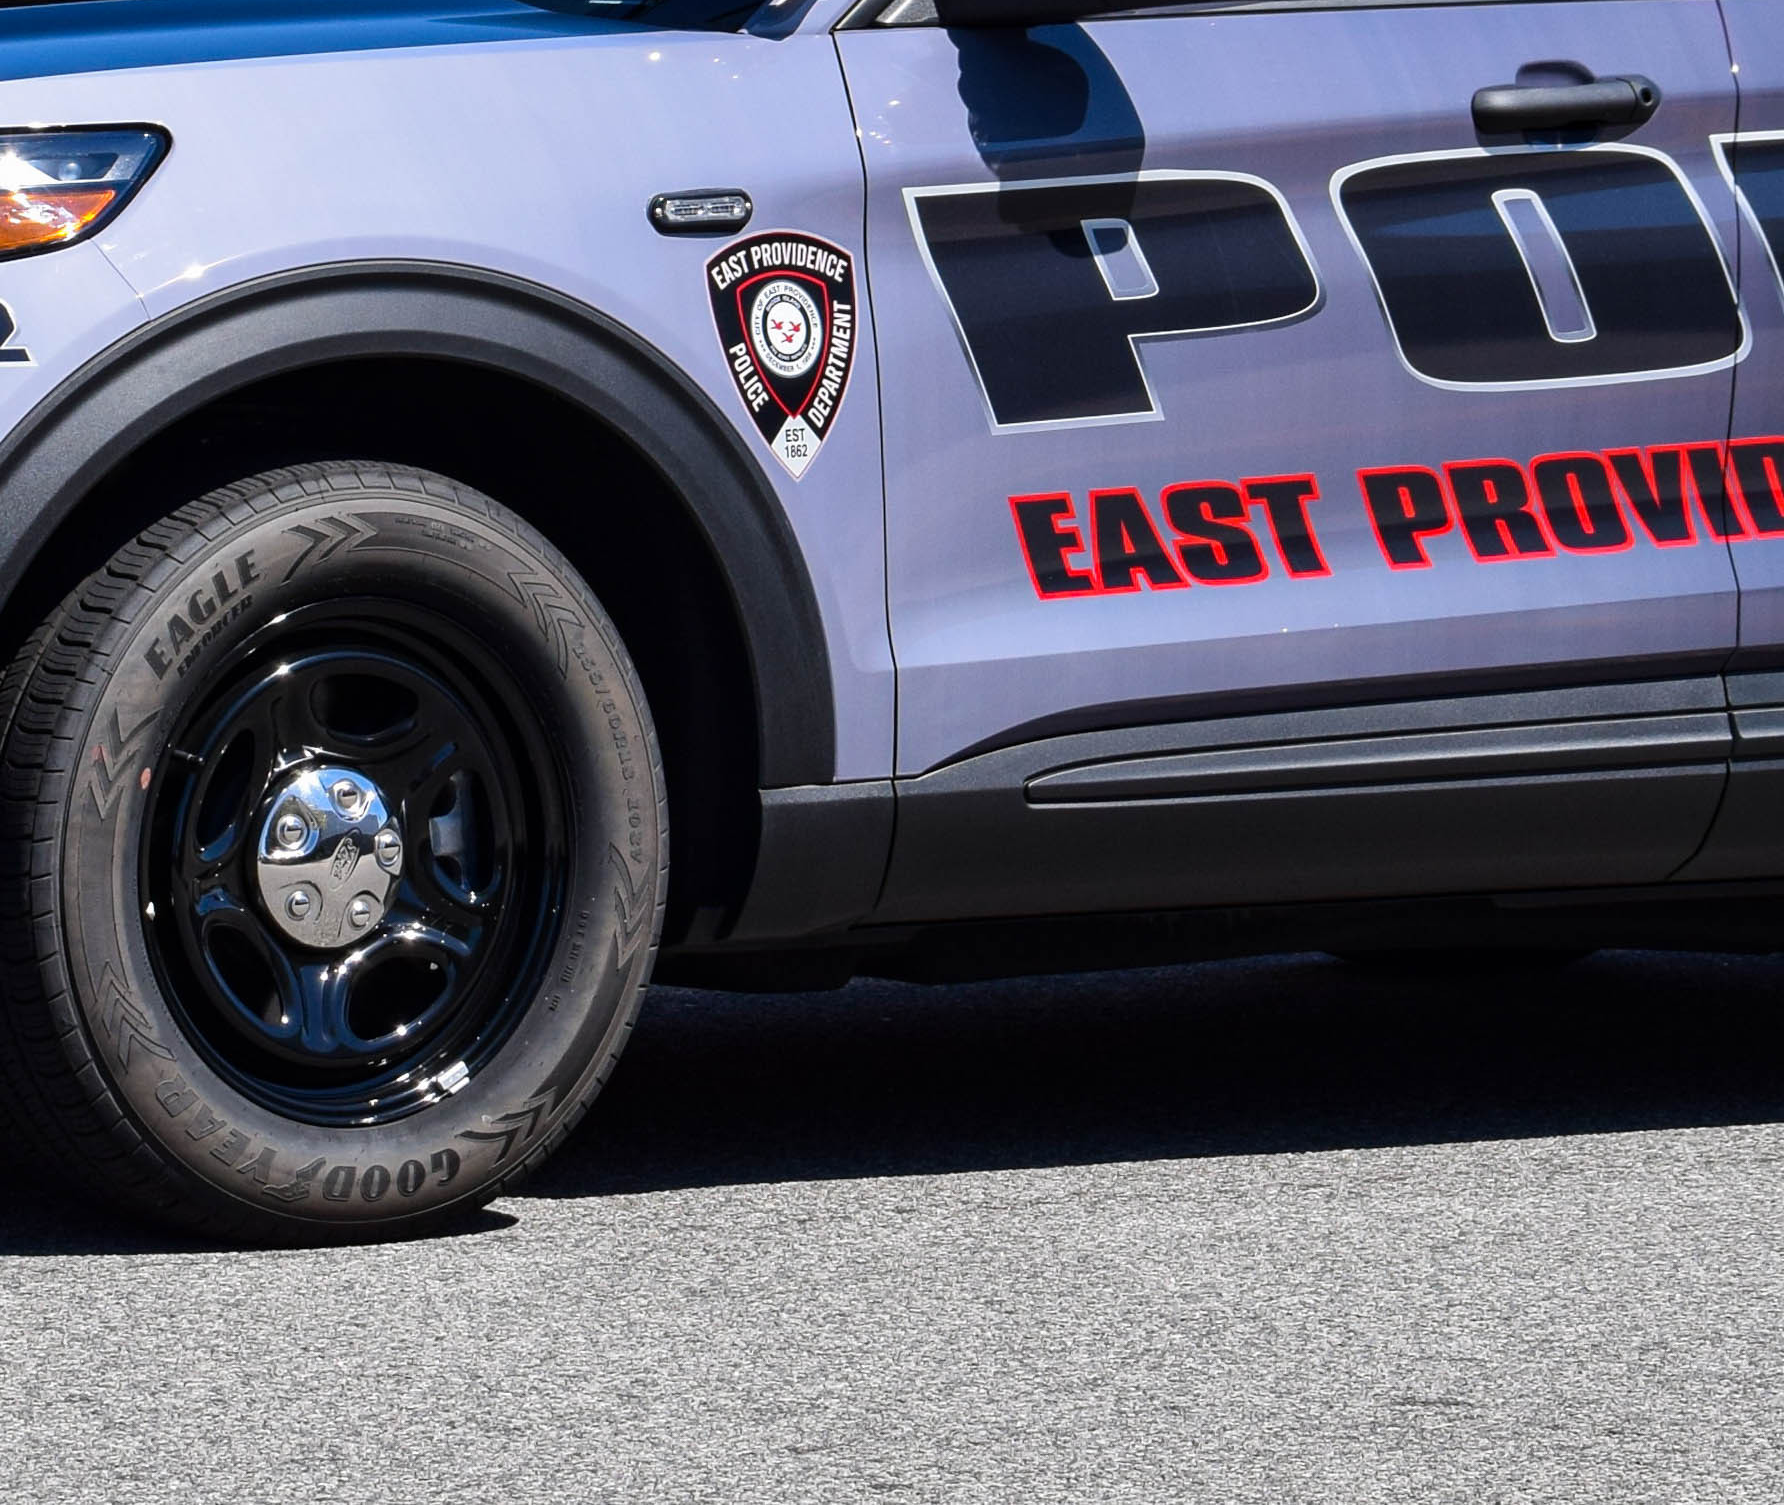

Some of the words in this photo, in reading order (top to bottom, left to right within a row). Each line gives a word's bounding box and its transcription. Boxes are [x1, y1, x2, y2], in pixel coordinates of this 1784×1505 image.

[710, 249, 749, 291] EAST
[751, 242, 848, 283] PROVIDENCE
[729, 342, 770, 413] POLICE
[807, 300, 853, 429] DEPARTMENT
[784, 445, 808, 459] 1862
[785, 428, 805, 443] EST
[1007, 472, 1334, 601] EAST
[144, 548, 261, 681] EAGLE
[154, 1070, 462, 1202] GOODYEAR
